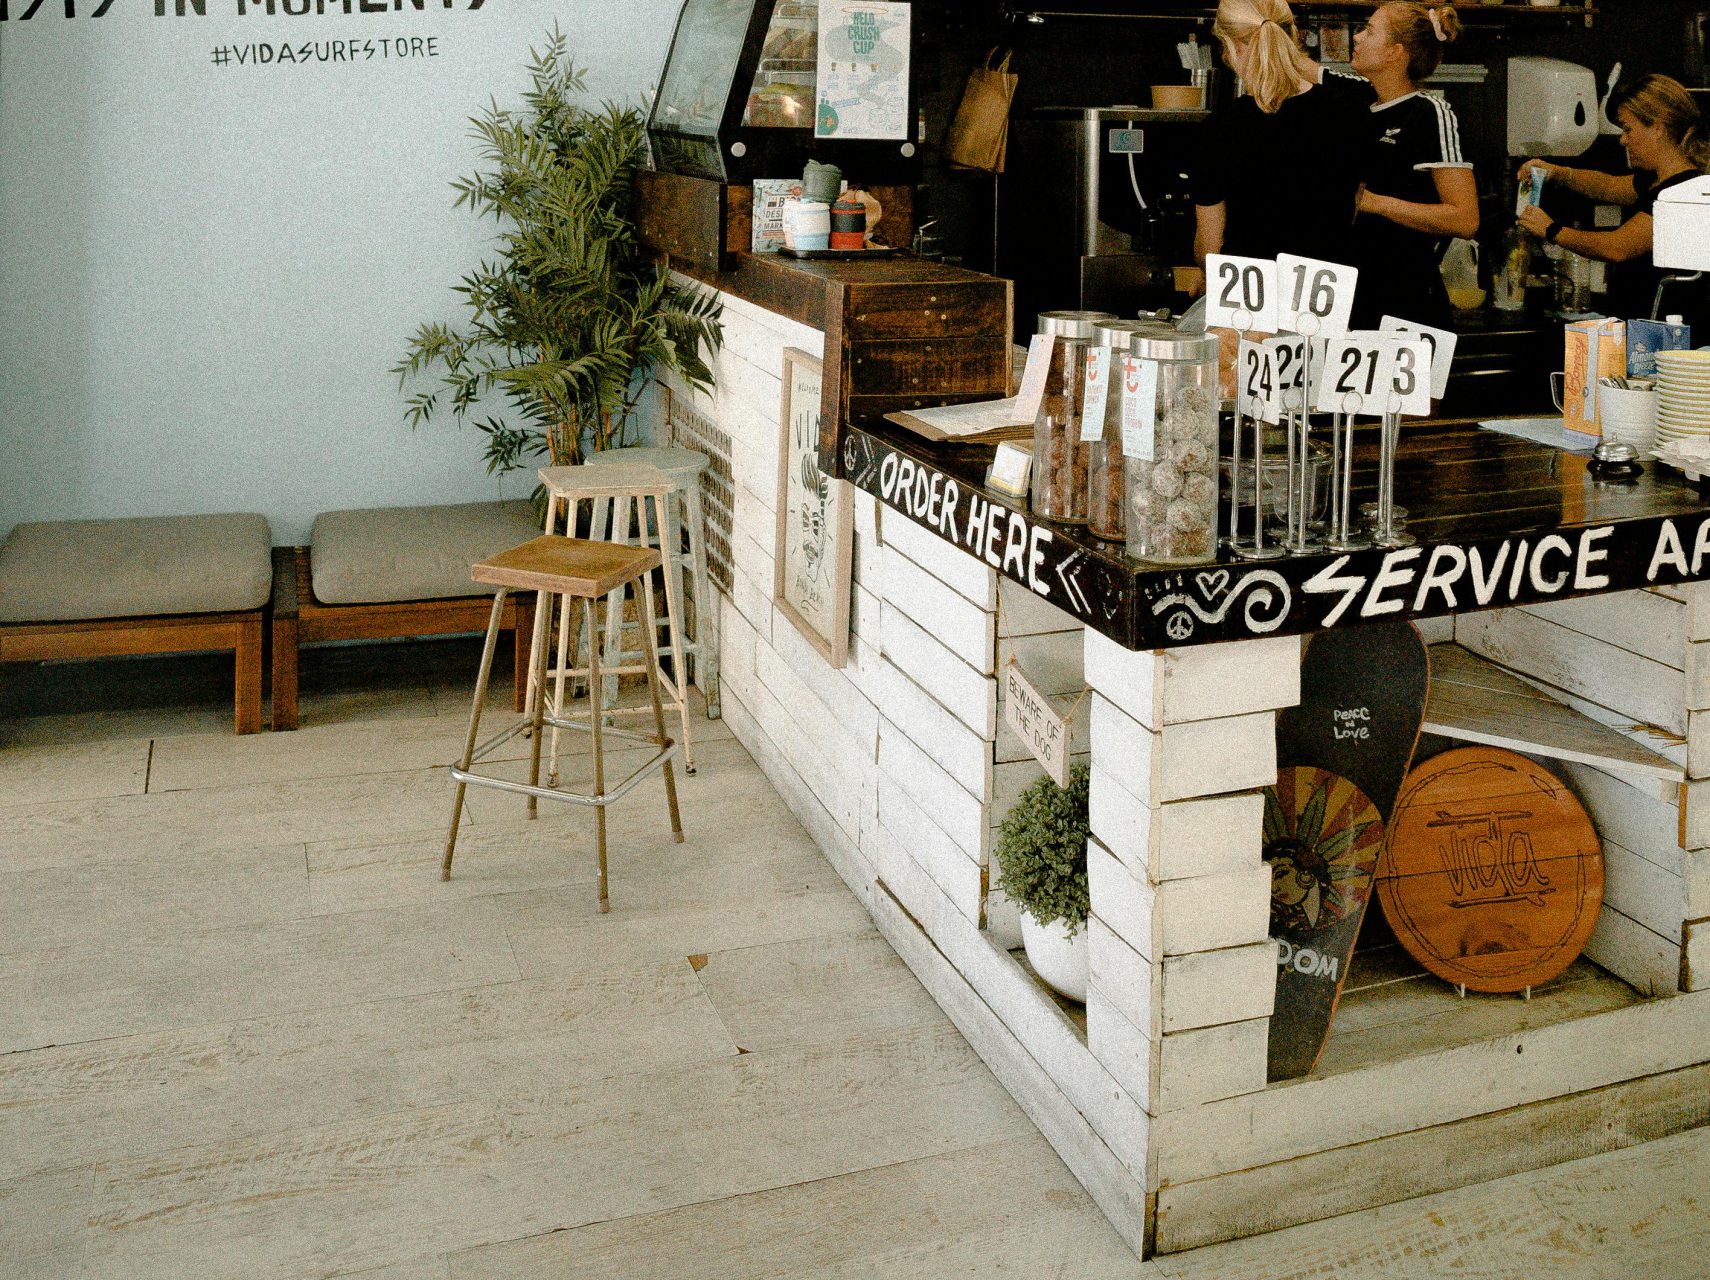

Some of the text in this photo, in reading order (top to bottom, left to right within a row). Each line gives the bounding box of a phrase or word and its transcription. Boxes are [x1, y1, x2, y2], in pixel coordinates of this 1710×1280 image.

[210, 36, 440, 66] #VIDASURFSTORE
[852, 40, 875, 55] CUP
[1218, 262, 1265, 312] 20
[1291, 264, 1337, 318] 16
[1247, 348, 1272, 402] 24
[1275, 343, 1314, 390] 22
[1336, 347, 1379, 395] 21
[880, 452, 1053, 596] ORDER HERE
[1301, 524, 1614, 628] SERVICE
[1009, 675, 1060, 741] BEWARE OF
[1015, 704, 1051, 761] THE DOG
[1333, 726, 1370, 739] Love
